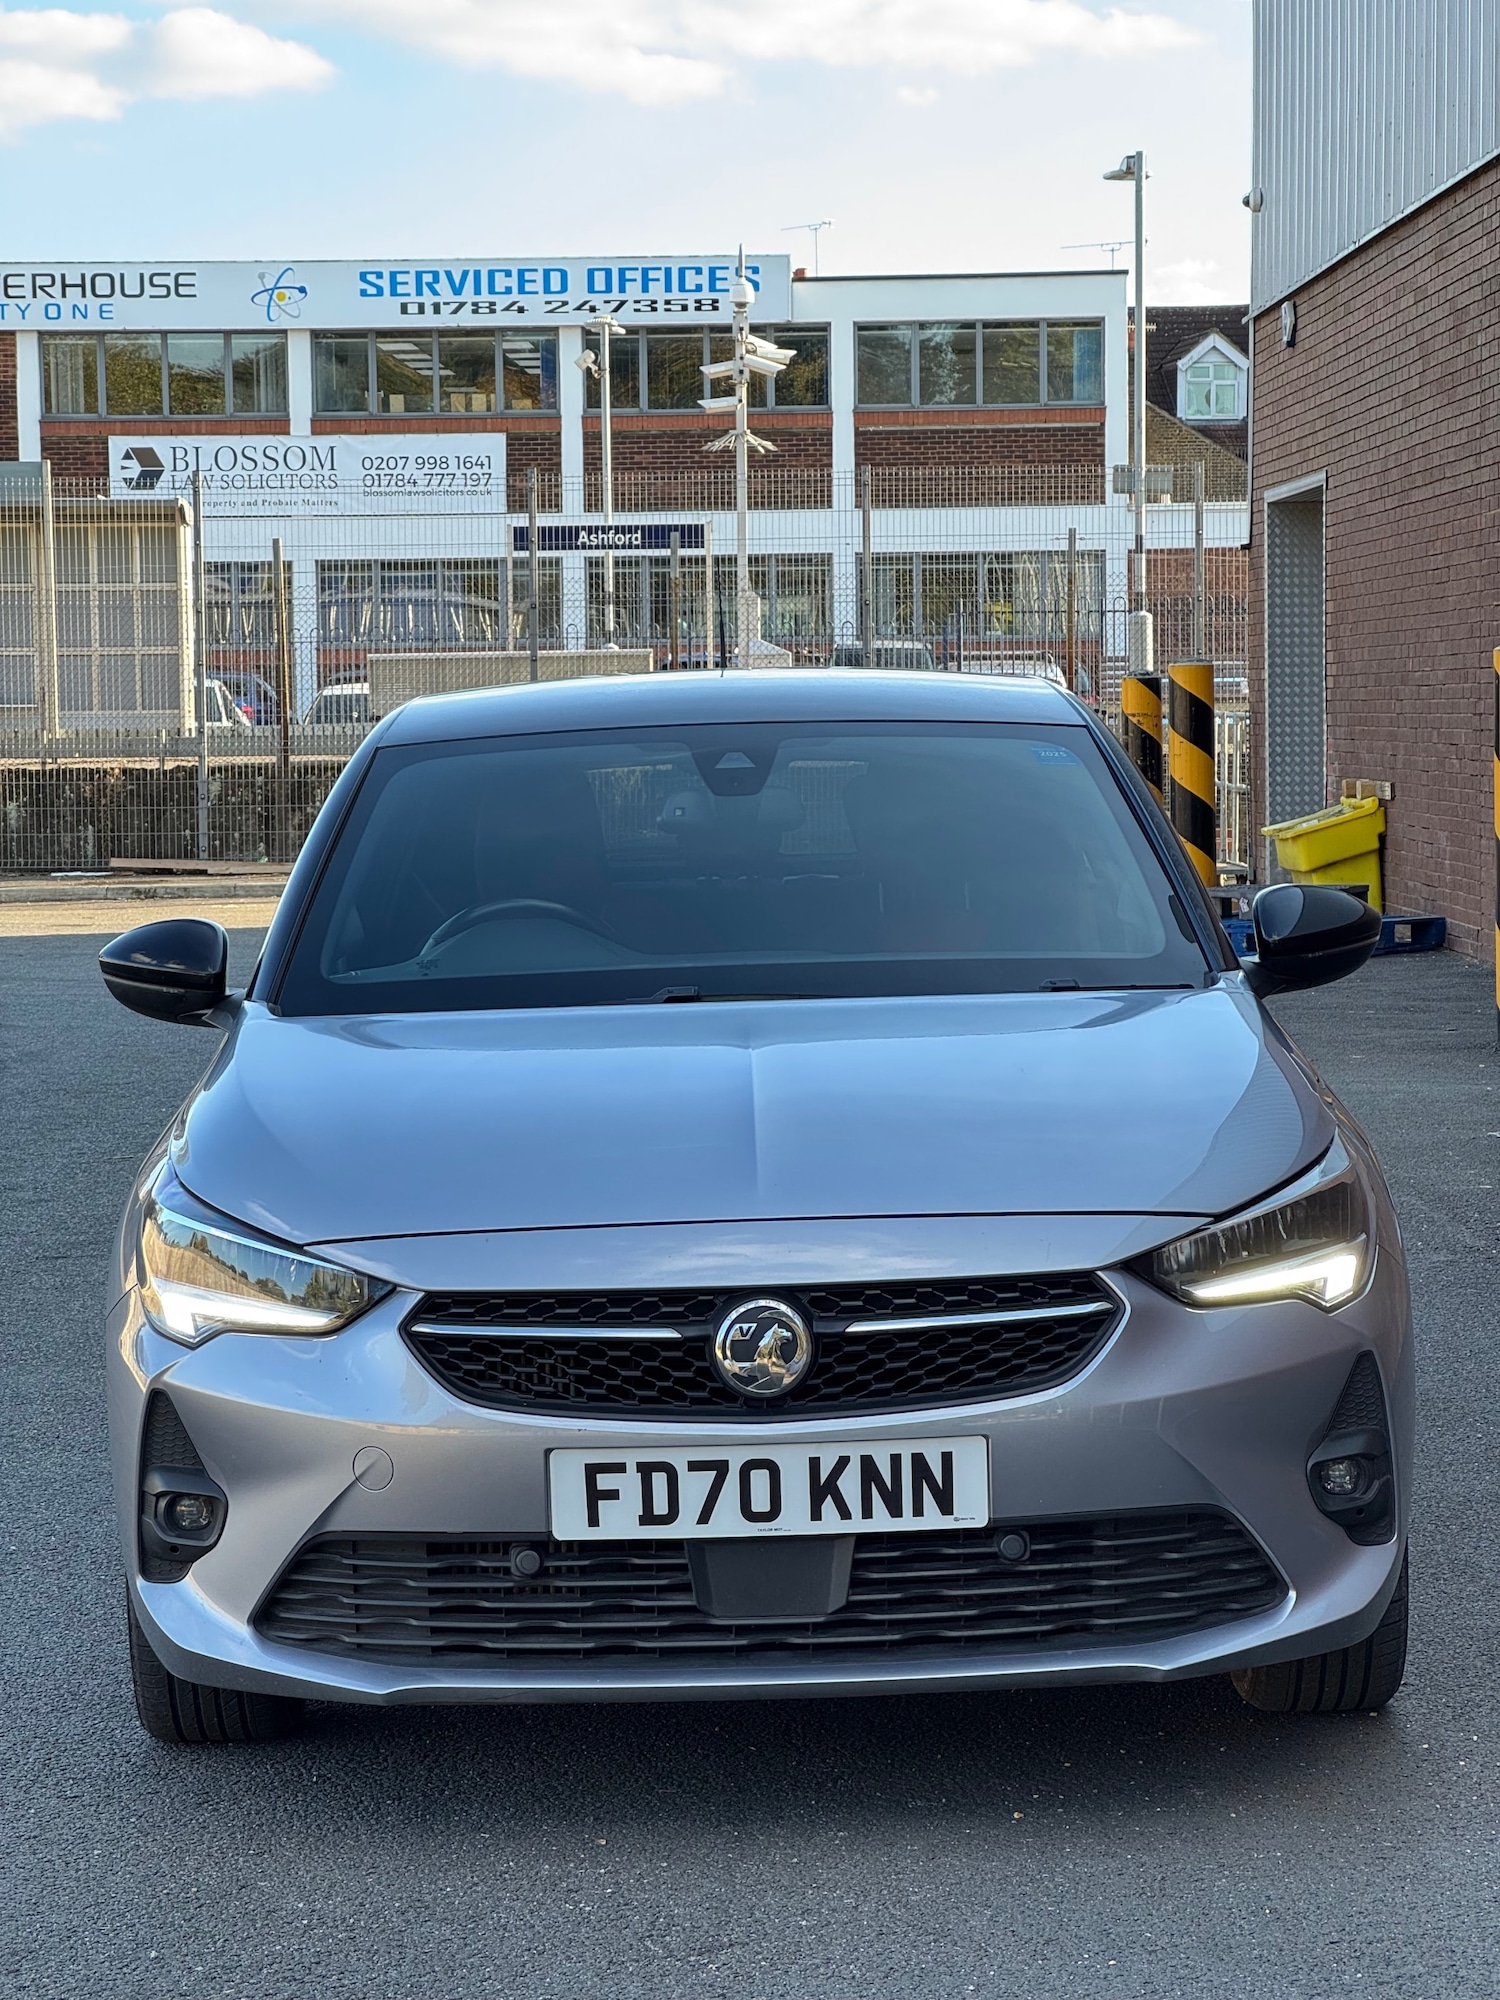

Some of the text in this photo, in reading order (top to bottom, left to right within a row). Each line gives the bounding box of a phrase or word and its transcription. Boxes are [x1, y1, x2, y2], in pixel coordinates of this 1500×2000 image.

[0, 272, 197, 299] ERHOUSE
[359, 268, 568, 297] SERVICED
[44, 303, 114, 320] ONE
[400, 298, 719, 315] 01784 247358
[170, 445, 337, 472] BLOSSOM
[361, 456, 492, 471] 0207 998 1641
[220, 473, 338, 490] SOLICITORS
[362, 472, 492, 488] 01784 777 197
[202, 498, 338, 509] roperty and Probate Matters
[577, 529, 641, 545] Ashford
[584, 1451, 954, 1527] FD70 KNN
